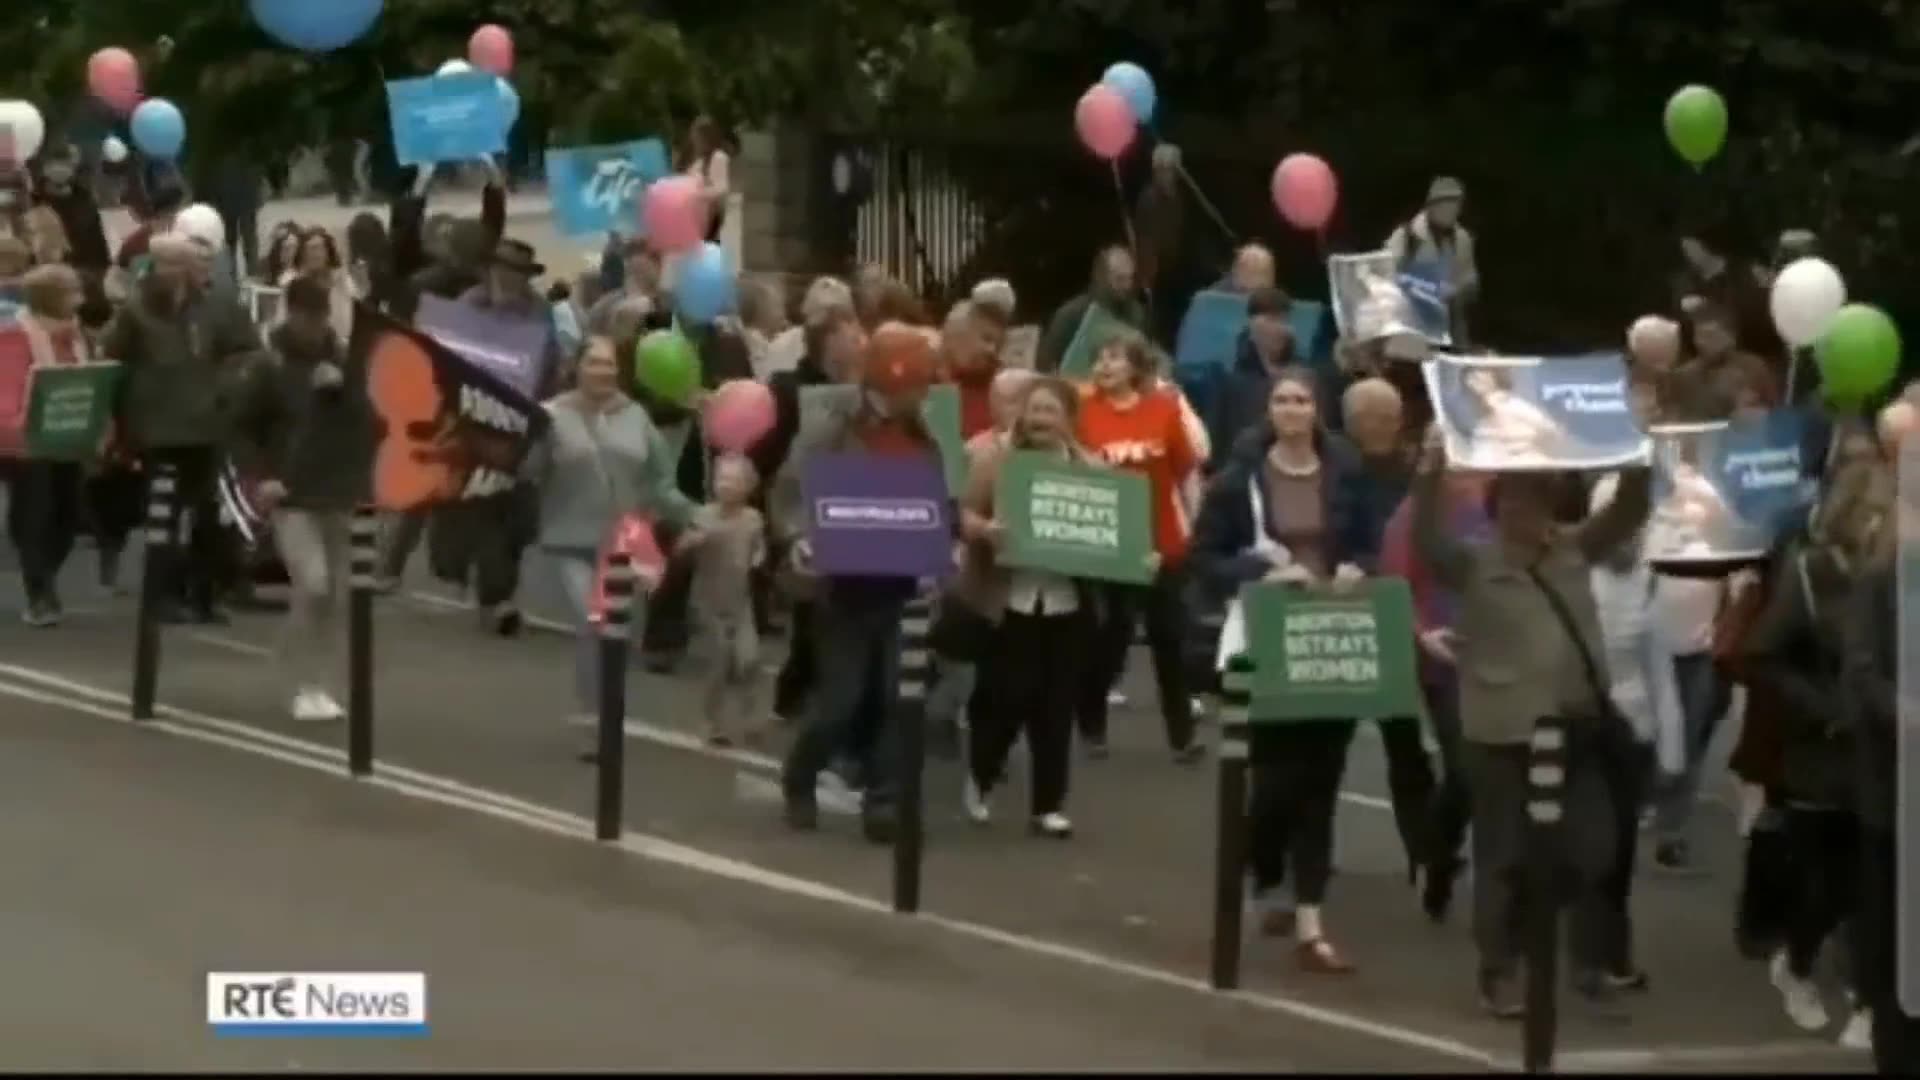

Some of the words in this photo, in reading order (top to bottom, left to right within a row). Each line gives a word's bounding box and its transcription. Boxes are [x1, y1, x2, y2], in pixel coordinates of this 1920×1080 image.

[1031, 499, 1119, 528] BETRAYS
[1031, 520, 1119, 547] WOMEN
[1286, 633, 1378, 656] BETRAYS
[1288, 658, 1378, 681] WOMEN
